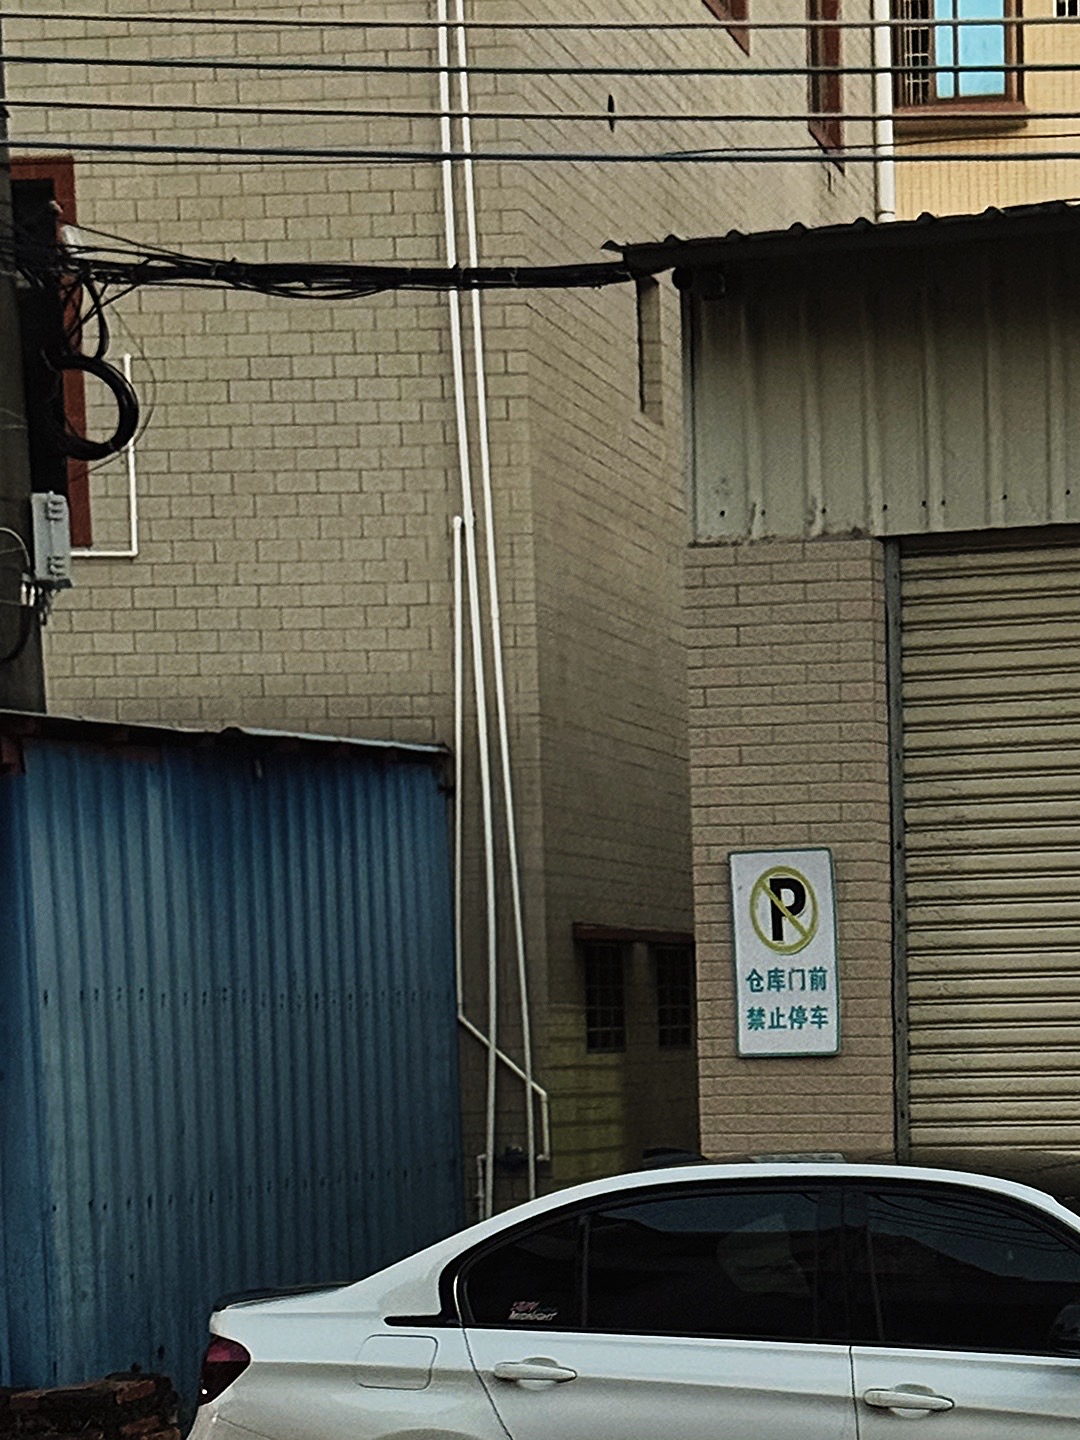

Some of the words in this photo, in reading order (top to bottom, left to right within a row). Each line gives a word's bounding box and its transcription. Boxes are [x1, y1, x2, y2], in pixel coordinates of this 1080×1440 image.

[769, 878, 806, 941] P
[745, 967, 828, 992] 仓库门前
[747, 1005, 829, 1031] 禁止停车
